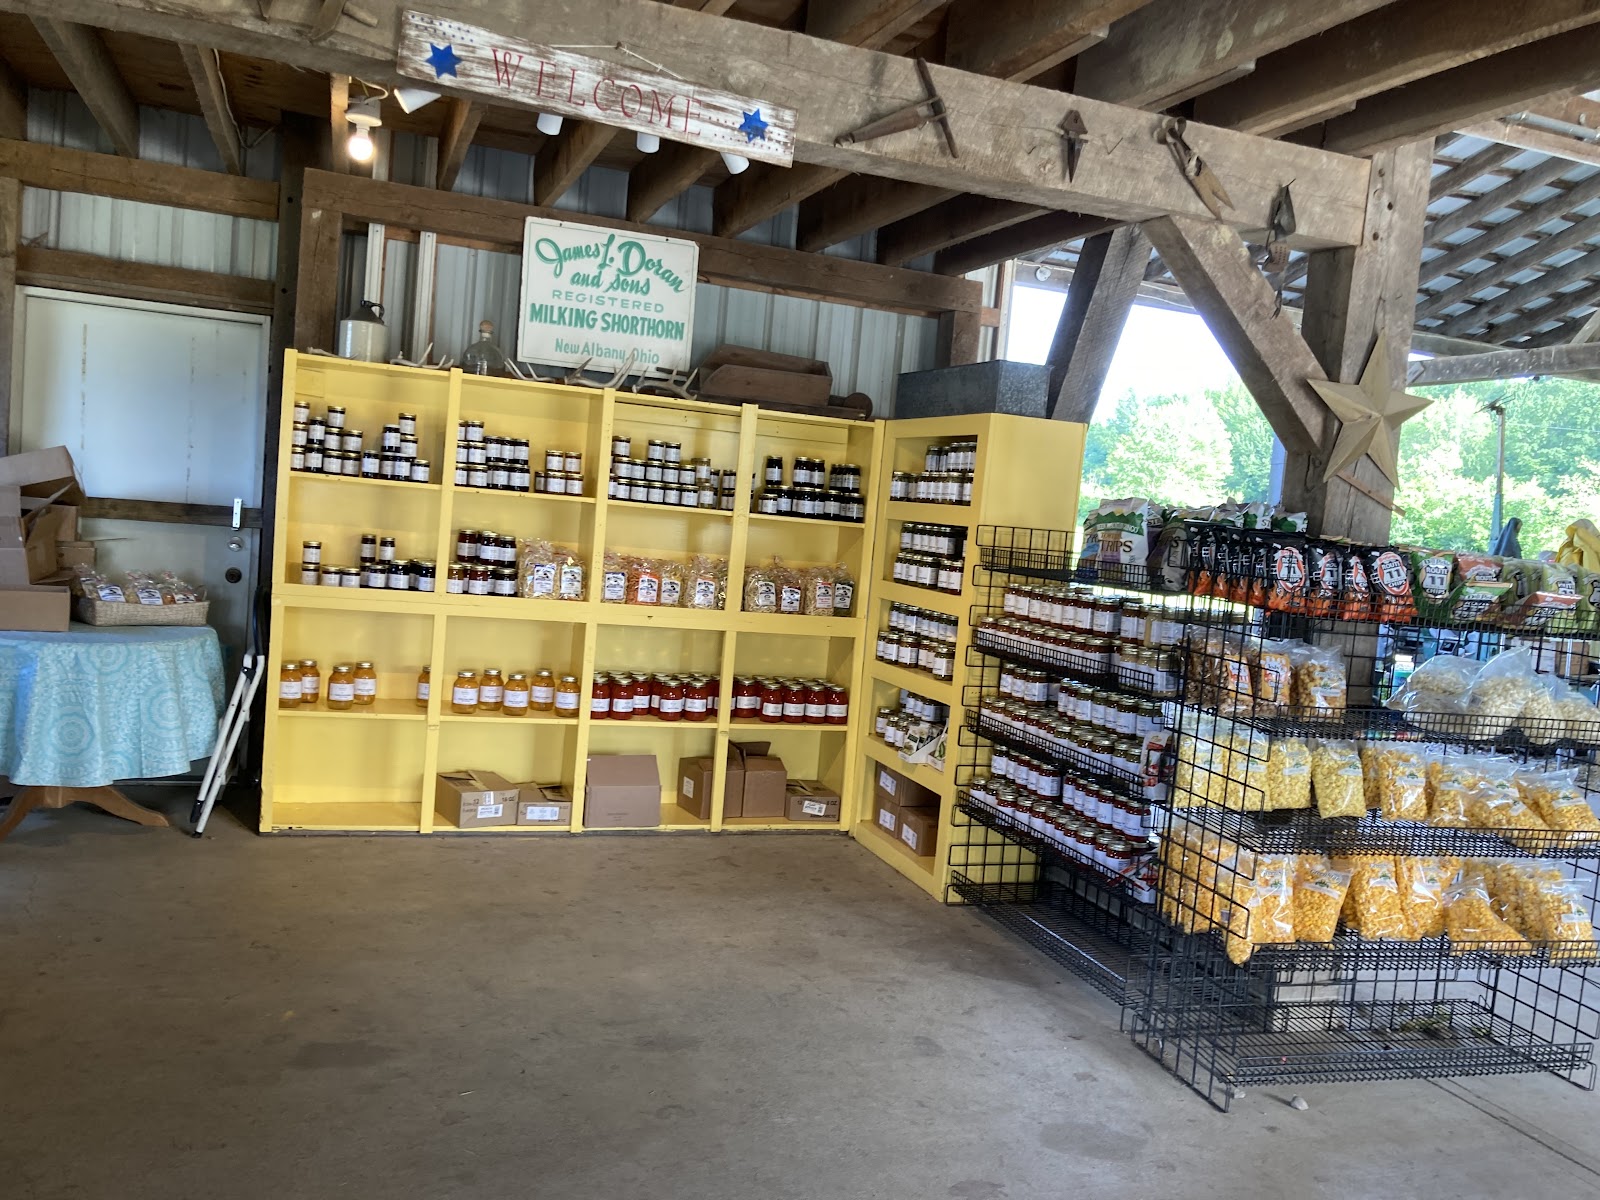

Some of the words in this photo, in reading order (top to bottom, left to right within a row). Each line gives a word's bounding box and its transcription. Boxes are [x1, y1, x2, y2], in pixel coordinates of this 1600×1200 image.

[490, 47, 702, 136] WELCOME
[535, 238, 600, 278] James
[617, 241, 686, 293] Doran
[570, 271, 603, 288] and
[552, 289, 664, 313] REGISTERED
[529, 303, 598, 330] MILKING
[600, 312, 685, 341] SHORTHORN
[555, 338, 580, 355] New
[633, 347, 660, 365] Ohio
[1386, 568, 1402, 580] 11
[1426, 567, 1449, 575] ROUTE
[1429, 575, 1445, 586] 11
